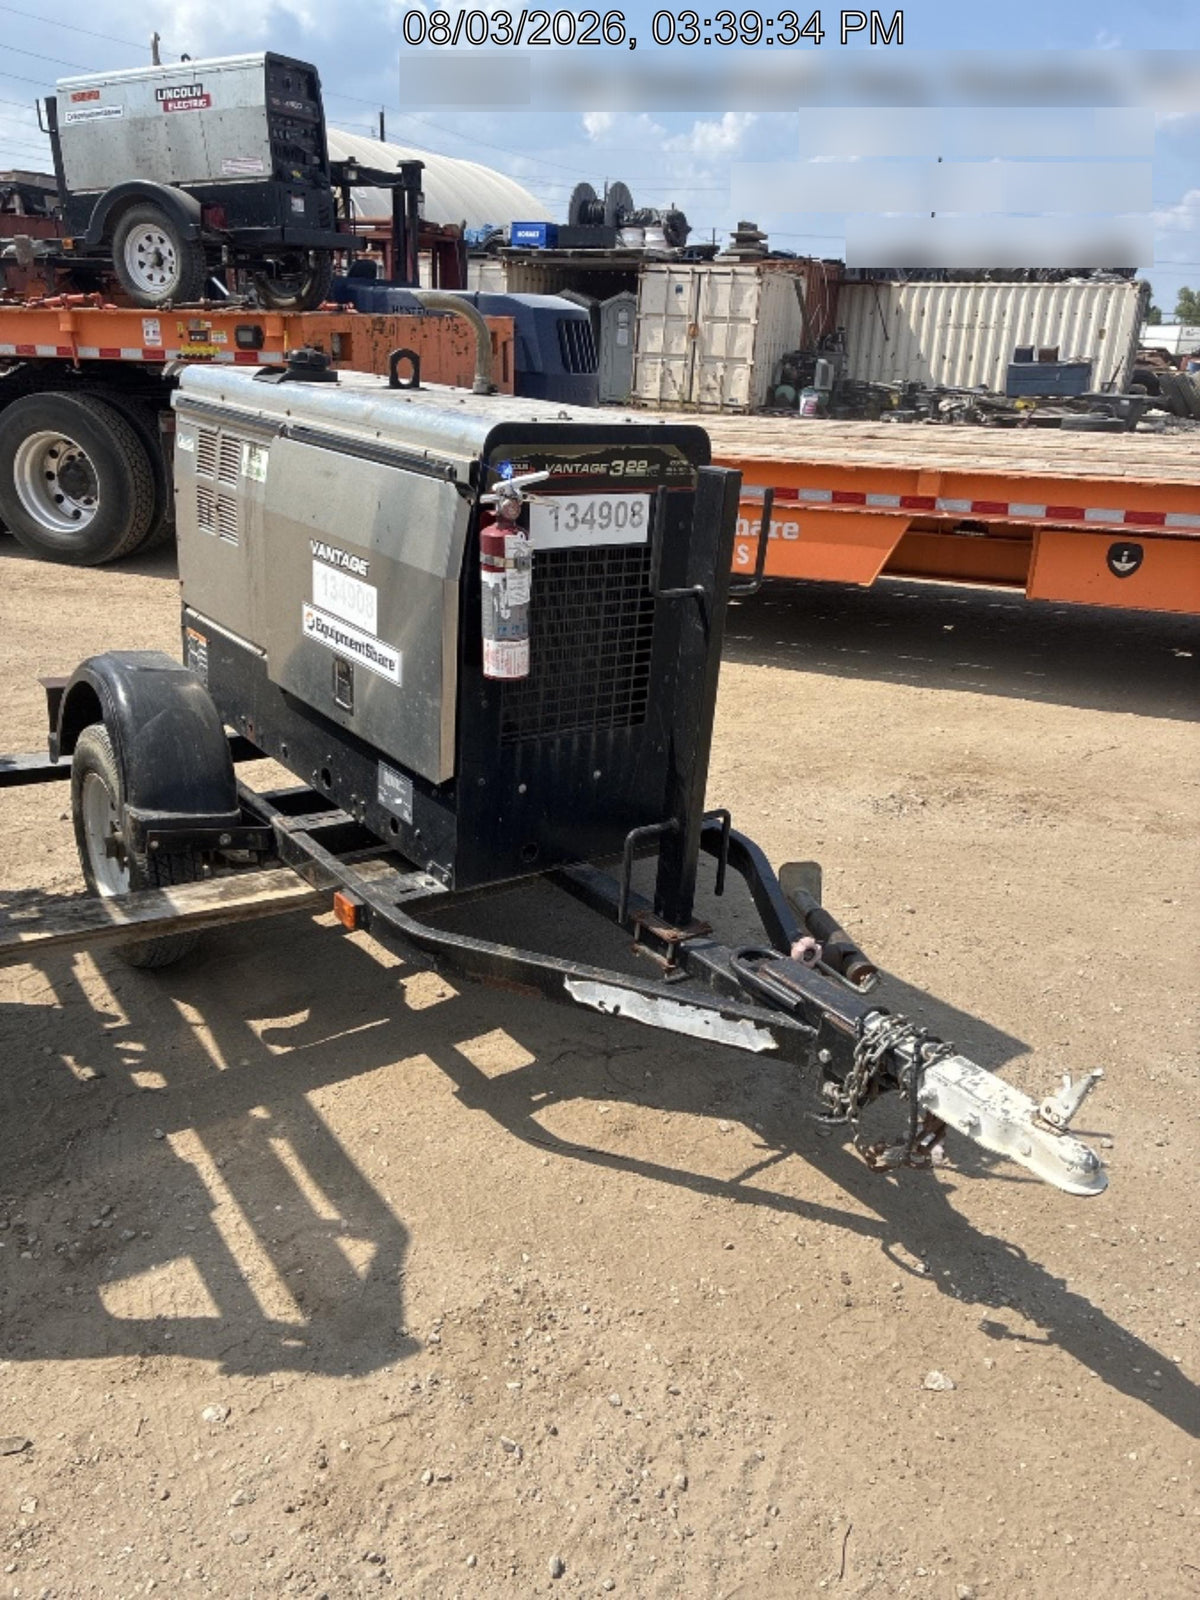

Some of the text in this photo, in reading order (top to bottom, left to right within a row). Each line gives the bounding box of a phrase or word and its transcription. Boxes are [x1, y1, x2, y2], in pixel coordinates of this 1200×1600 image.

[156, 85, 202, 100] LINCOLN
[168, 98, 208, 111] ELECTRIC
[545, 463, 610, 474] VANTAGE
[548, 500, 644, 532] 134908
[310, 539, 371, 577] VANTAGE
[320, 571, 375, 619] 134908
[315, 616, 396, 672] EquipmentShare
